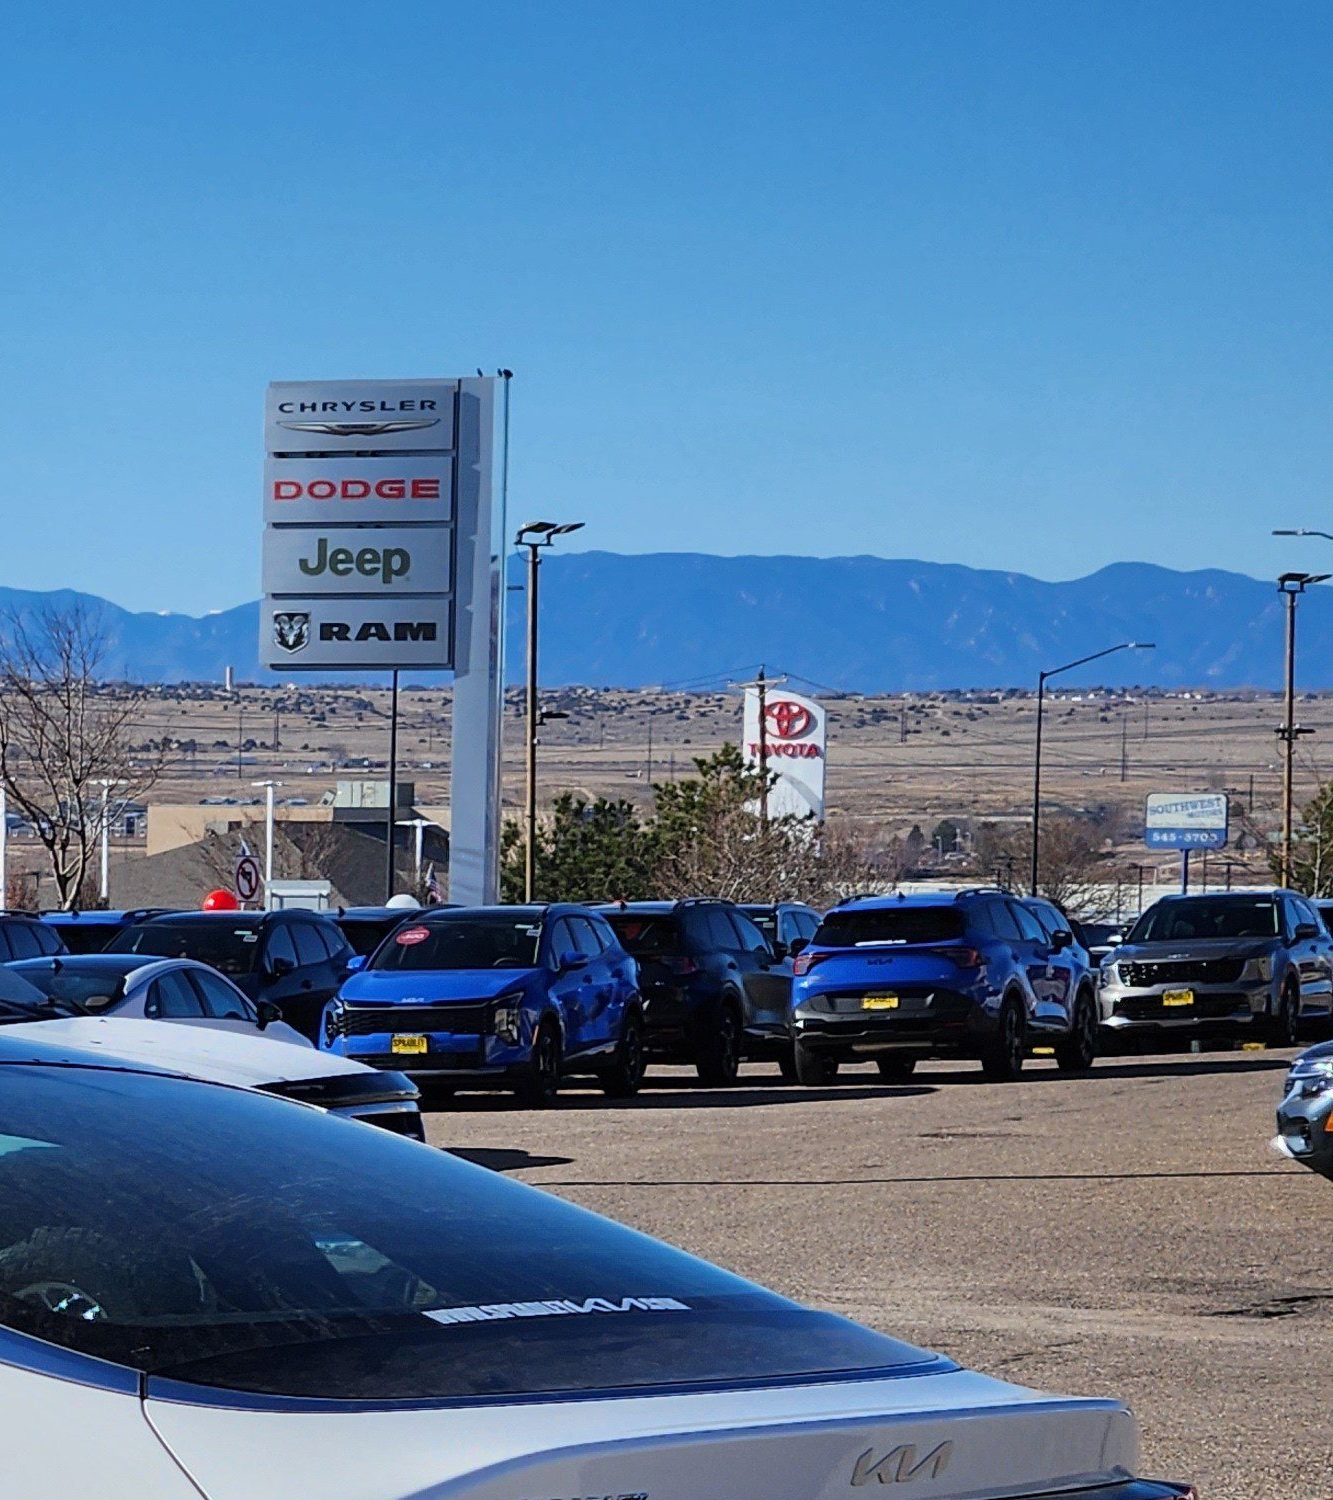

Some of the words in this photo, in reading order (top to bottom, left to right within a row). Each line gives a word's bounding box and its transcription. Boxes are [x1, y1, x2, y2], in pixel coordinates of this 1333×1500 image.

[278, 399, 437, 413] CHRYSLER
[274, 479, 440, 500] DODGE
[298, 537, 410, 584] Jeep
[320, 622, 437, 641] RAM
